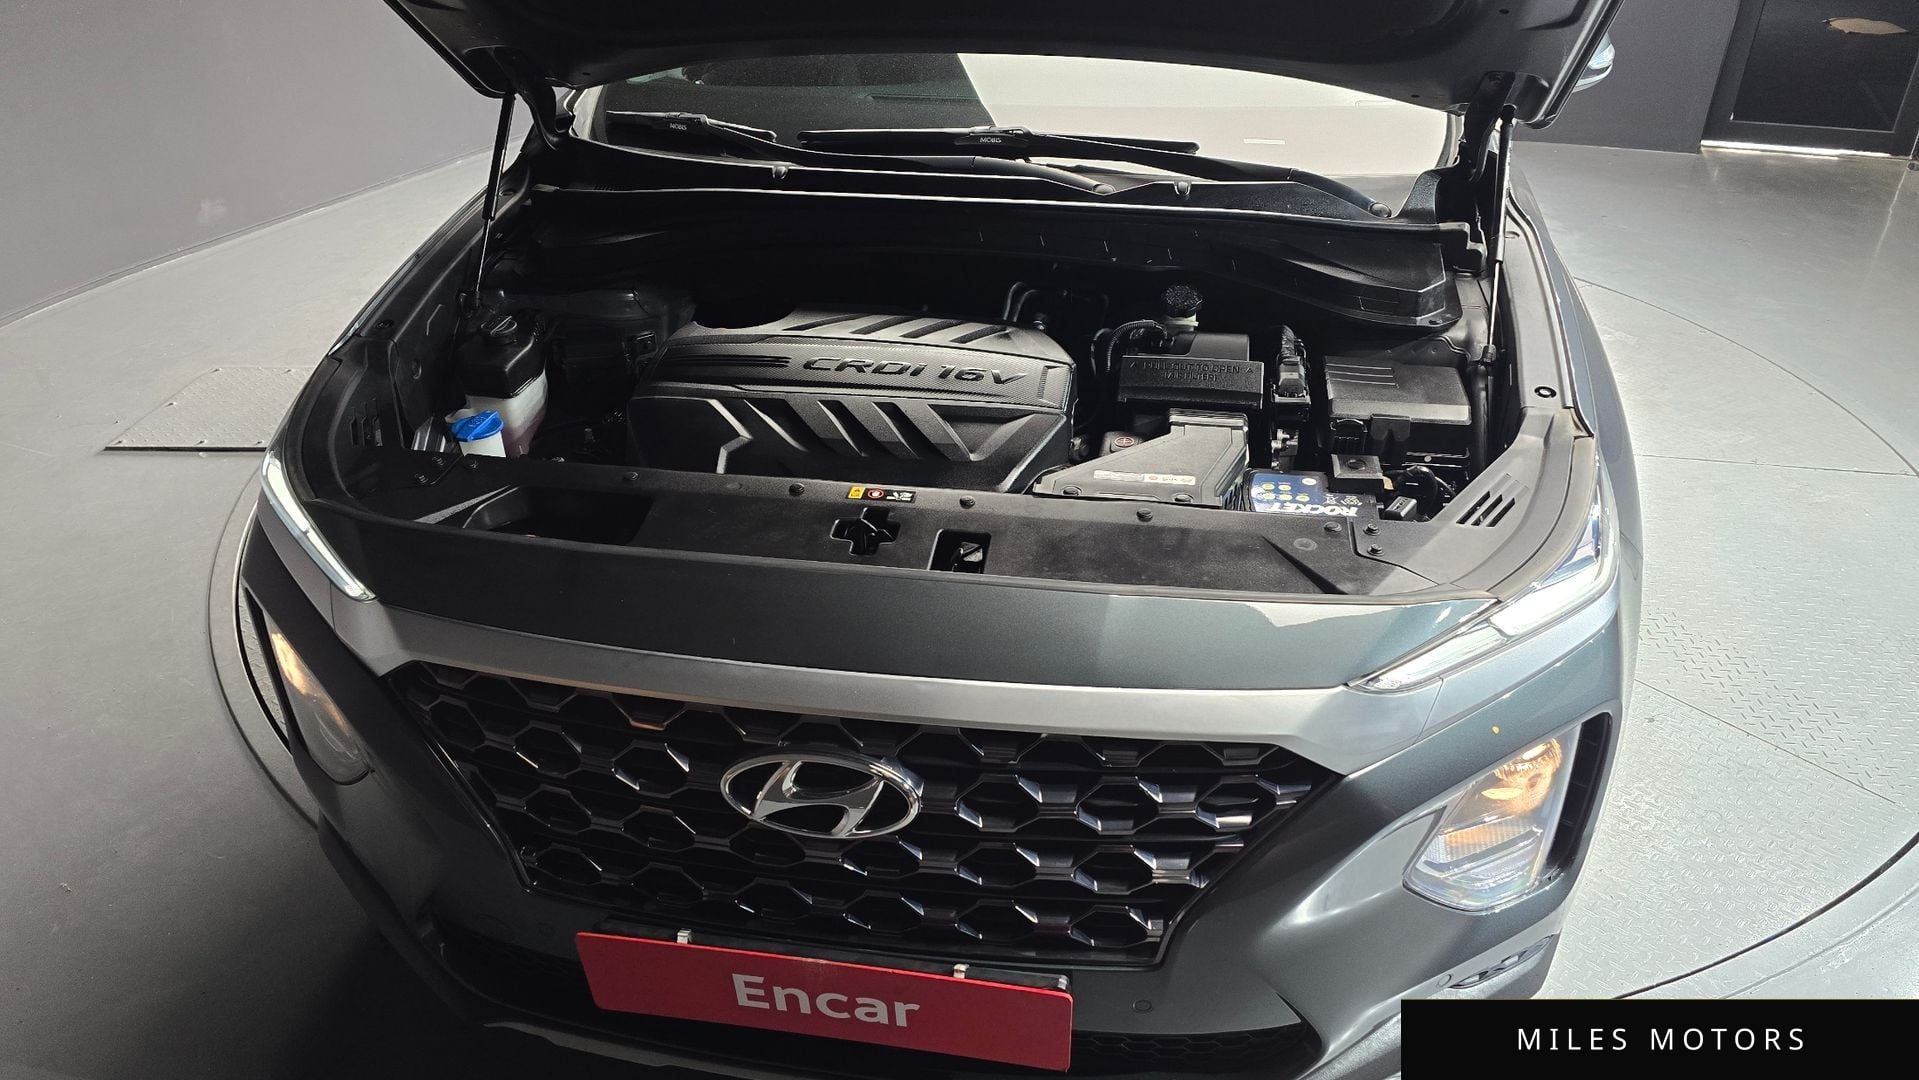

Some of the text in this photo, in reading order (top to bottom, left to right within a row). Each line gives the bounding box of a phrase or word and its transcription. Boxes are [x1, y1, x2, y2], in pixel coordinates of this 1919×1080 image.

[938, 364, 1028, 385] 16V
[1269, 502, 1359, 517] ROCKET
[731, 973, 921, 1027] Encar
